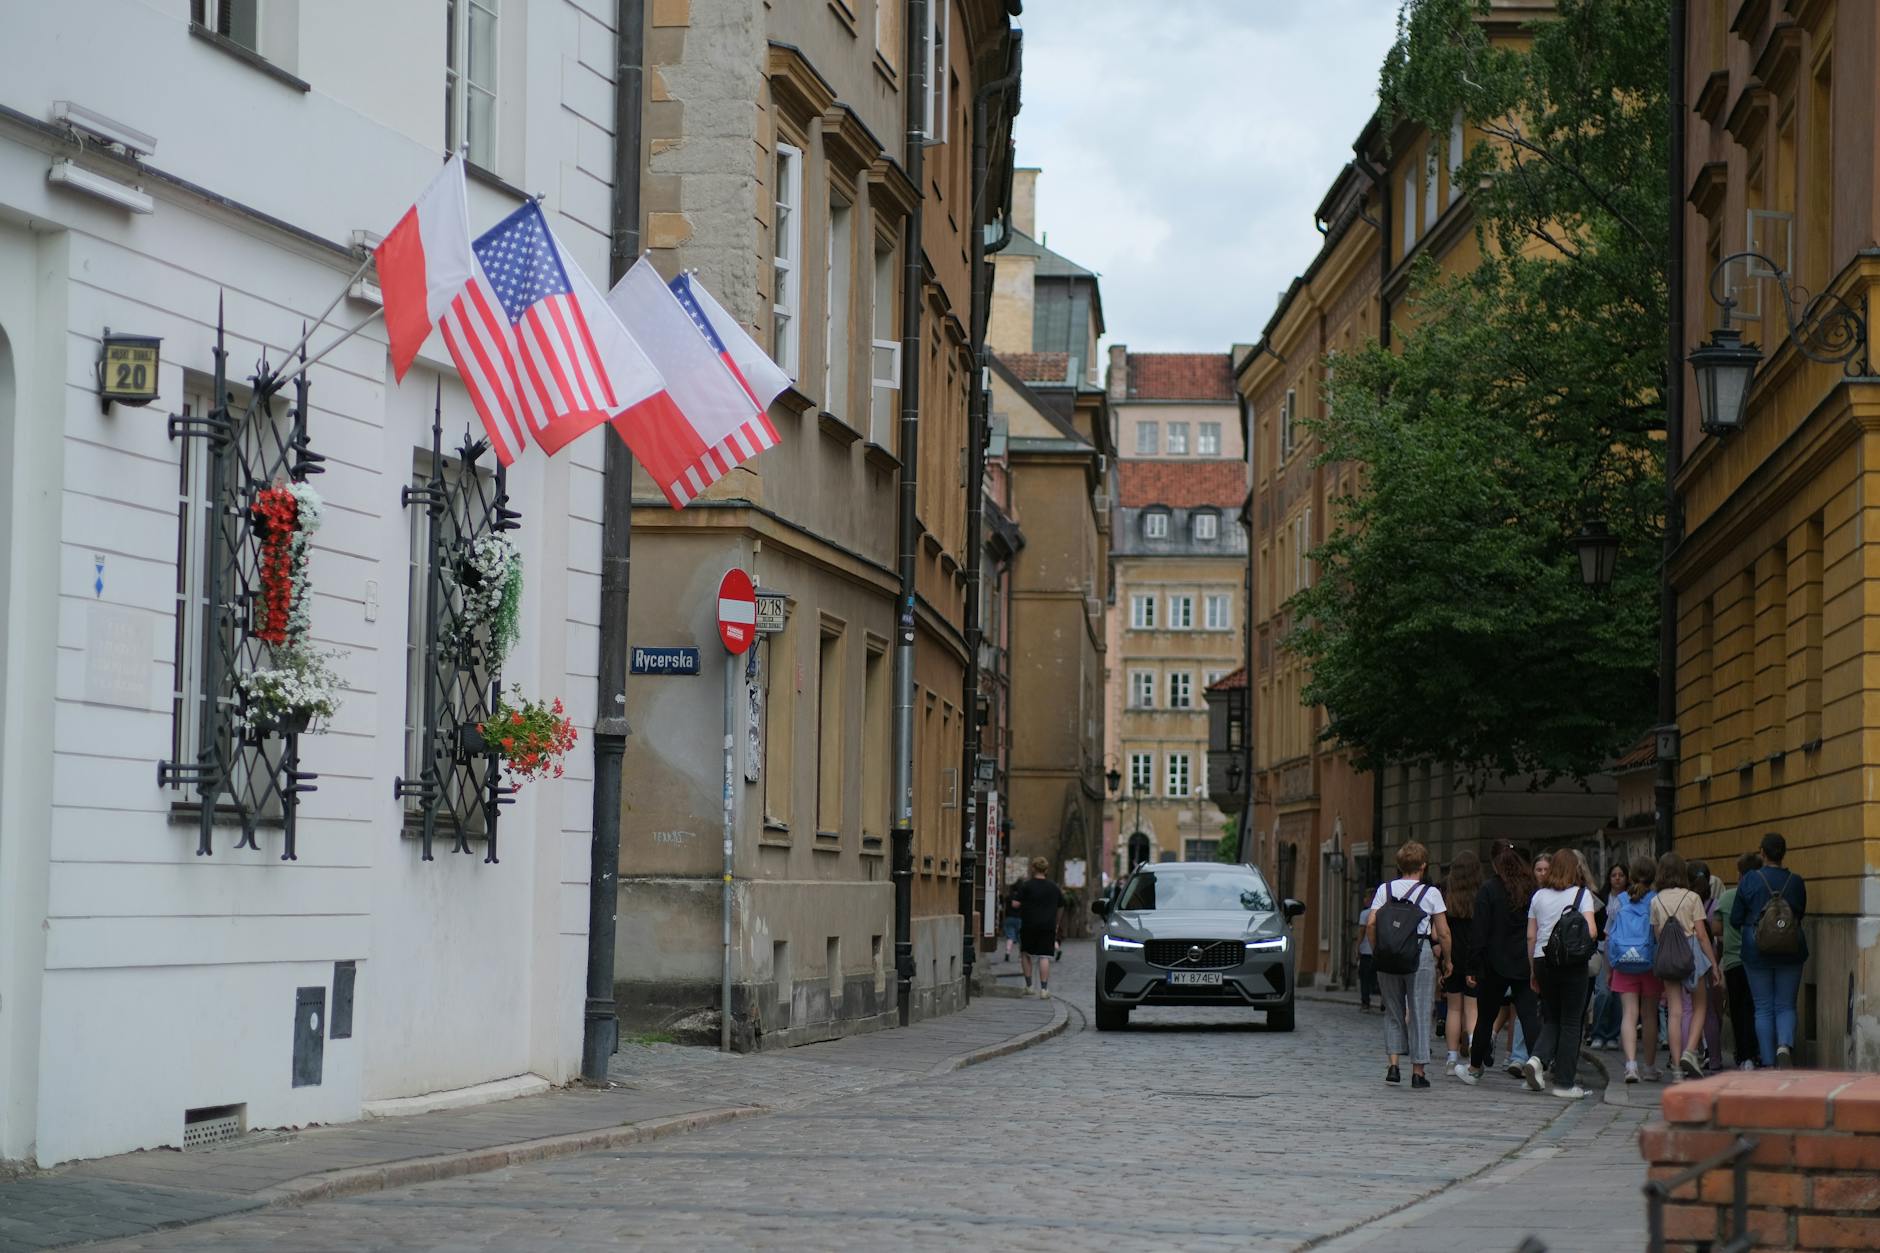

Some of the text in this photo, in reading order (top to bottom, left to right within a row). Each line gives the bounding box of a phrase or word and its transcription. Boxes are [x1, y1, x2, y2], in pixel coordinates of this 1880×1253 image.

[116, 363, 146, 389] 20
[635, 649, 693, 672] Rycerska
[1174, 973, 1220, 984] WY 874EV
